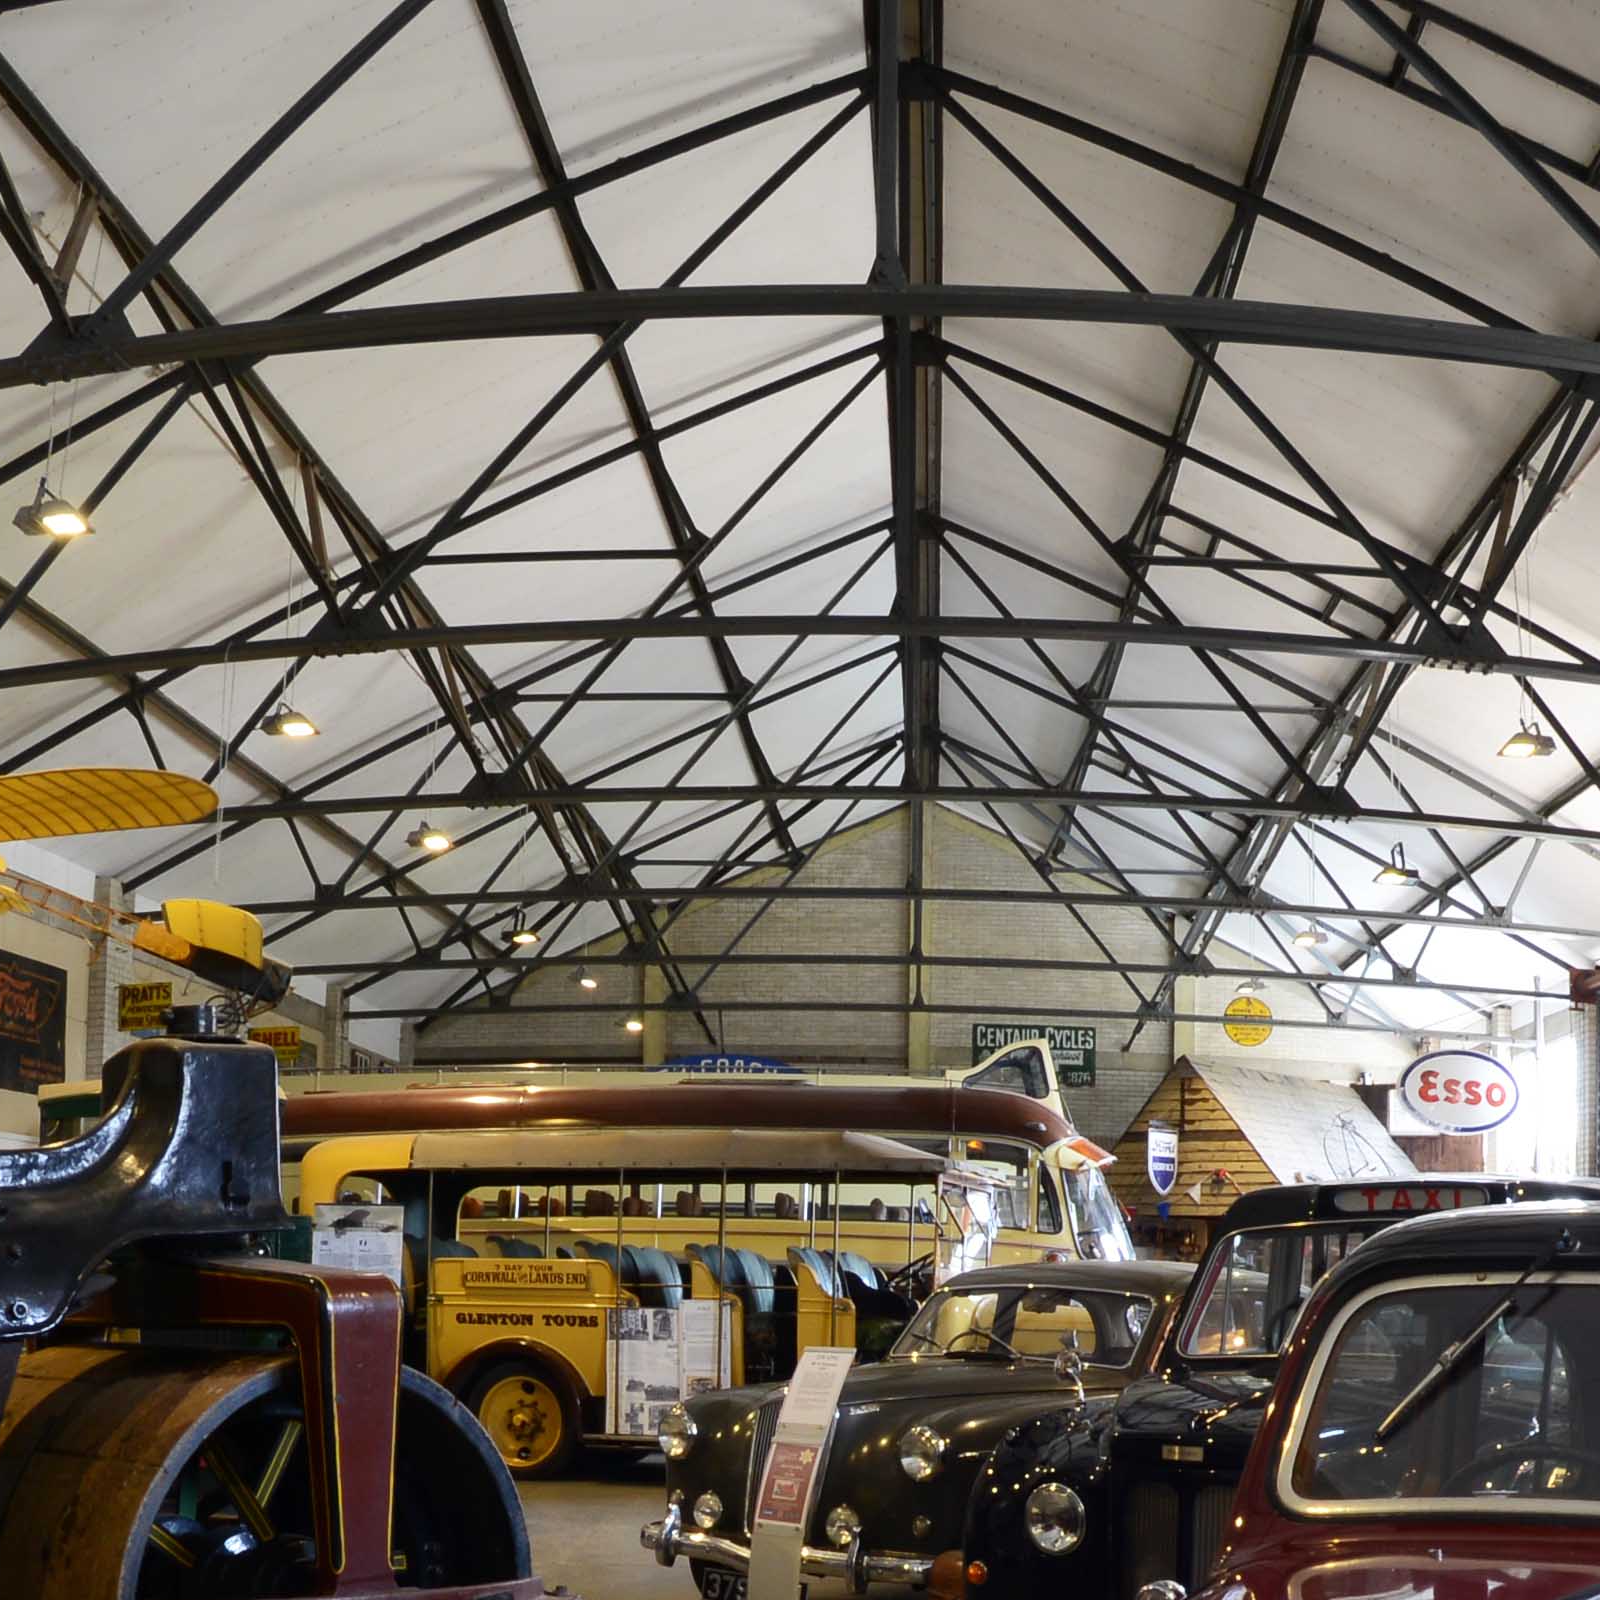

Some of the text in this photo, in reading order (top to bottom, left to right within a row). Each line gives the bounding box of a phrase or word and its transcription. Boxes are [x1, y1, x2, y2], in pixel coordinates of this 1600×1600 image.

[252, 1030, 299, 1047] SHELL
[1045, 1026, 1094, 1050] CYCLES
[1360, 1187, 1462, 1212] TAXI
[527, 1263, 554, 1272] TOUR
[465, 1271, 517, 1285] CORNWALL
[566, 1272, 586, 1286] END
[455, 1311, 599, 1328] GLENTON TOURS
